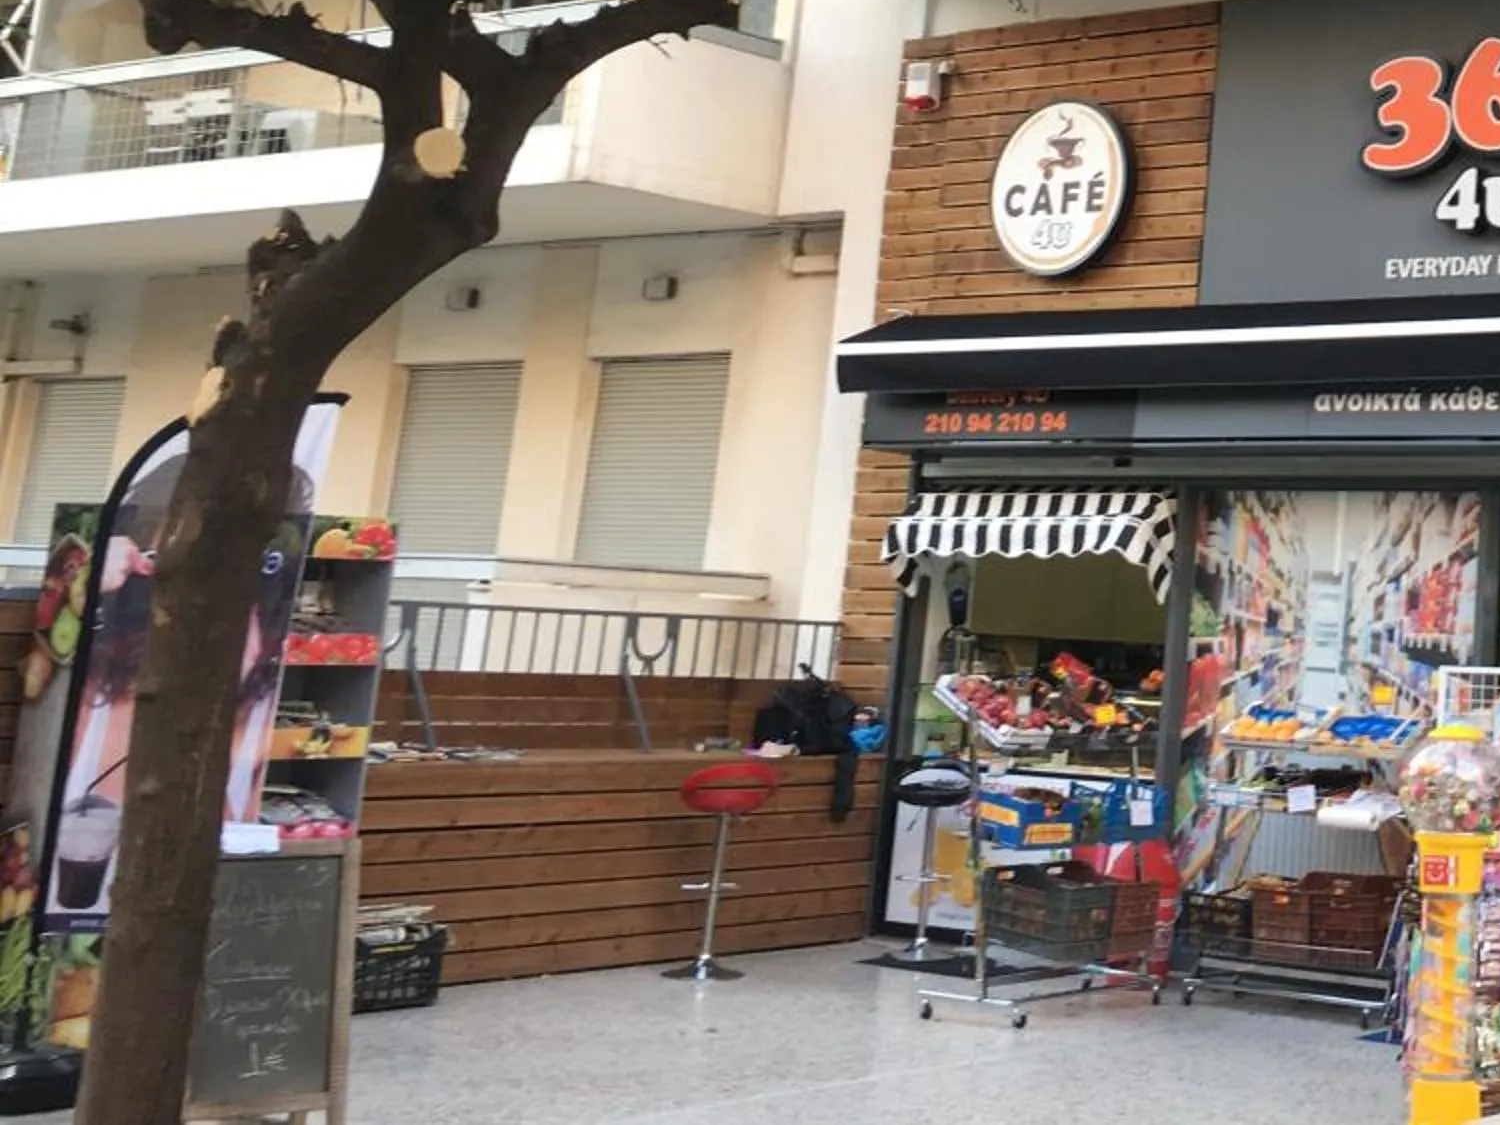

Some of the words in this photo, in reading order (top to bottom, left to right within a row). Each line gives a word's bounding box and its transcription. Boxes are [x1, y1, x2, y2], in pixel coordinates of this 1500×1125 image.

[1004, 172, 1105, 217] CAFÉ
[1385, 253, 1493, 279] EVERYDAY
[1313, 387, 1422, 412] ανοικτά
[1429, 386, 1500, 411] κάθε
[924, 412, 962, 433] 210
[967, 412, 993, 433] 94
[996, 412, 1035, 433] 210
[1040, 410, 1067, 432] 94
